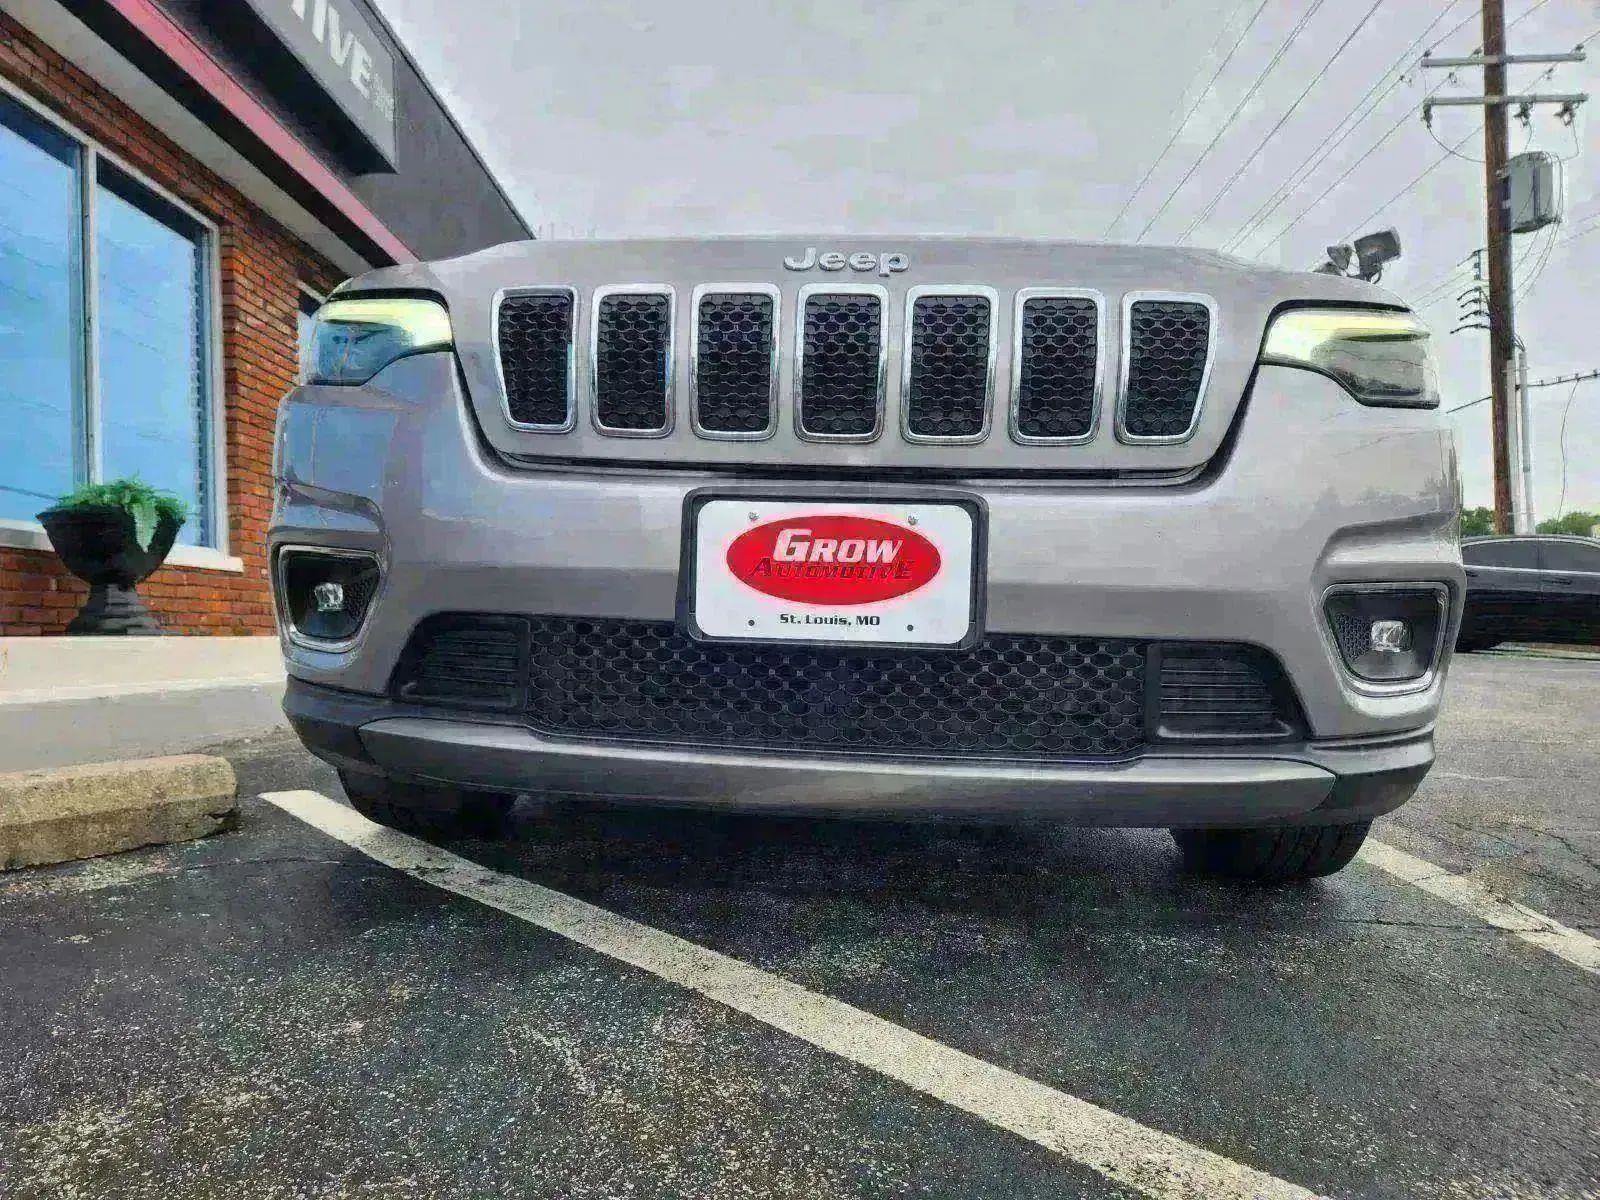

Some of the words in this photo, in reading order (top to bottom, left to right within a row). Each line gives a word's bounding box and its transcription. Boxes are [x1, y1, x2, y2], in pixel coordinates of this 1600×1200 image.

[783, 247, 909, 277] Jeep
[772, 528, 903, 563] GROW
[749, 557, 915, 581] AUTOMOTIVE
[780, 613, 801, 624] St.
[805, 614, 852, 626] Louis,
[856, 615, 880, 626] MO
